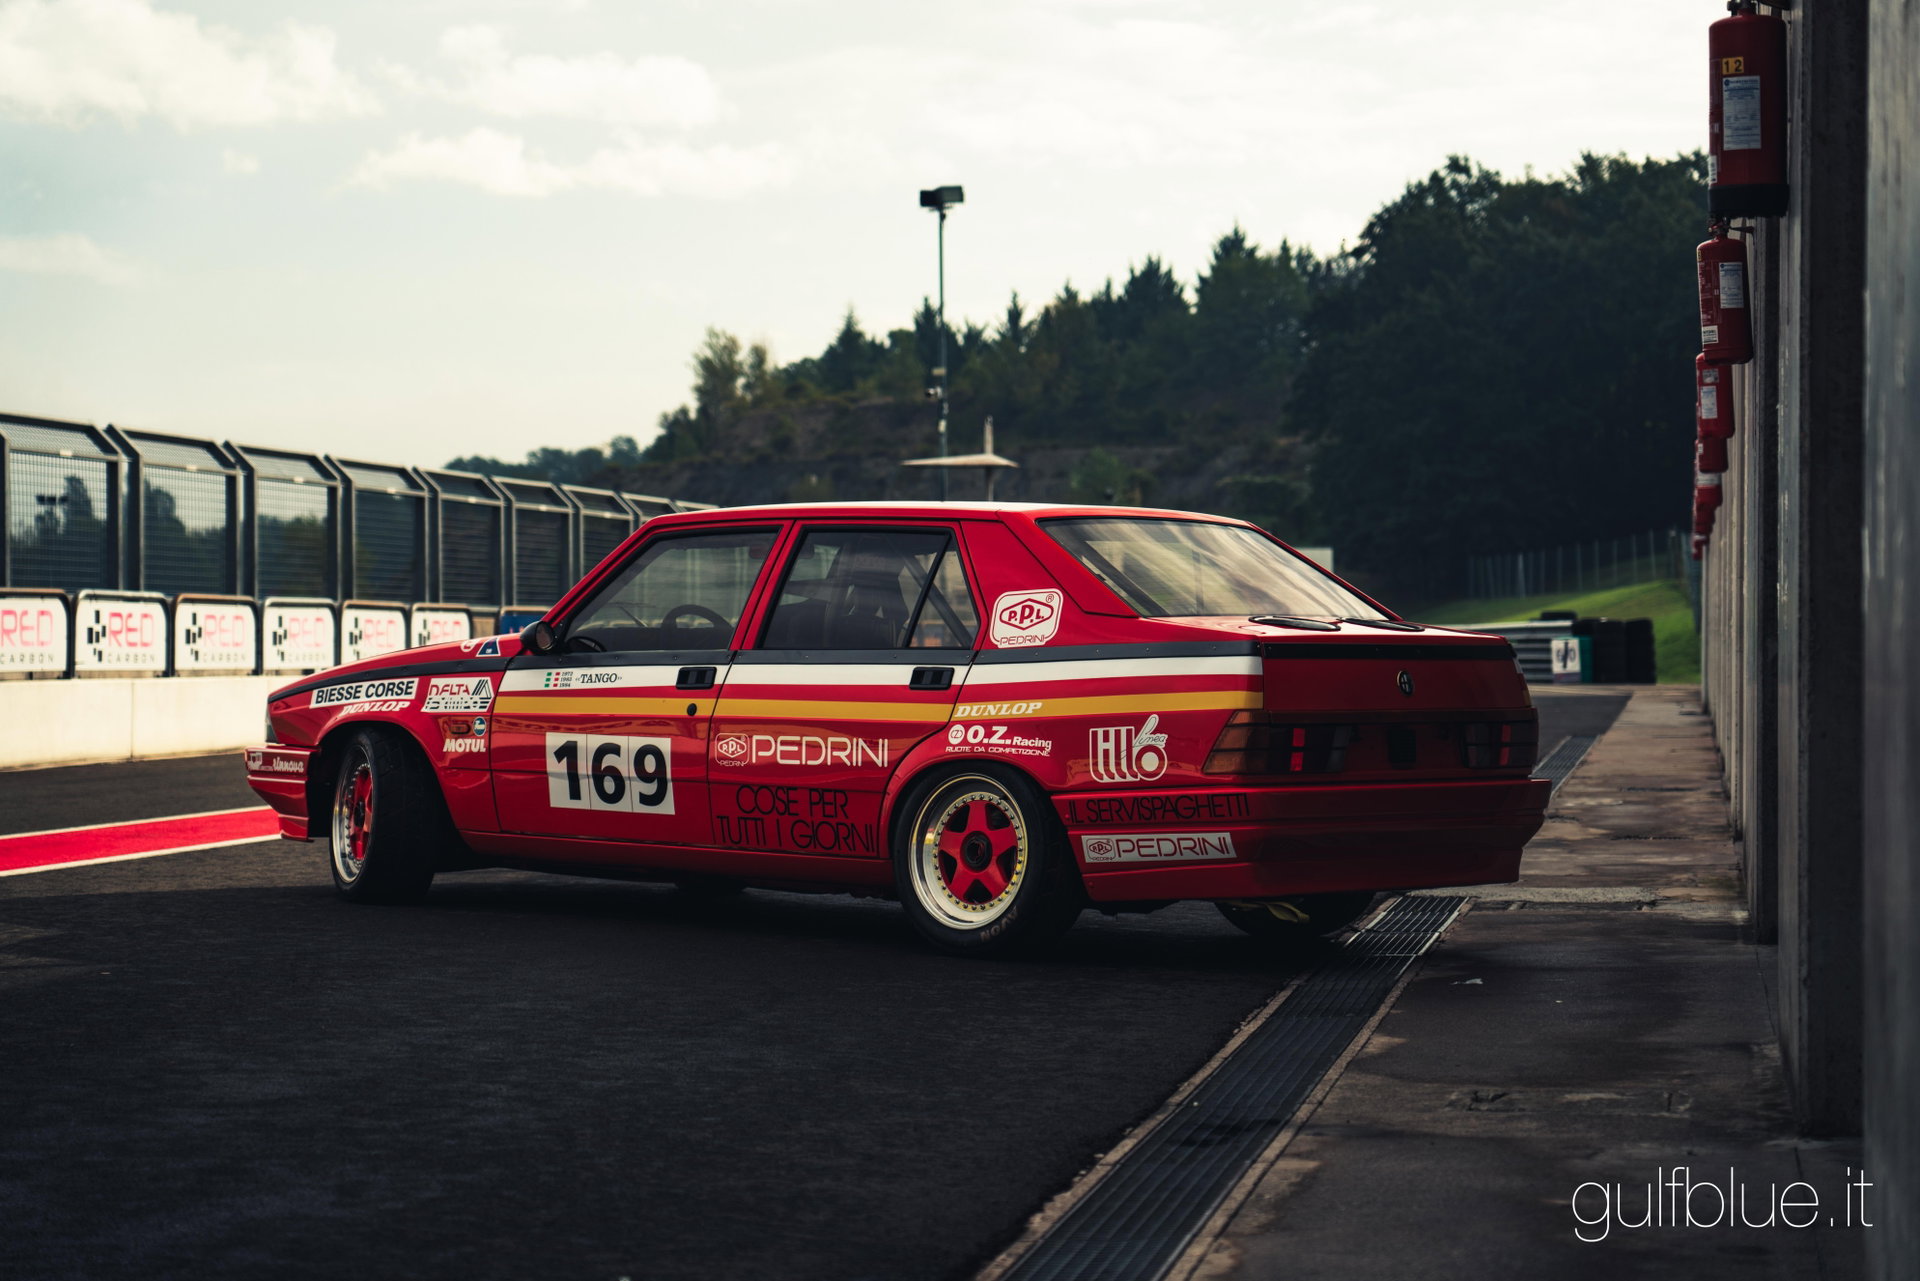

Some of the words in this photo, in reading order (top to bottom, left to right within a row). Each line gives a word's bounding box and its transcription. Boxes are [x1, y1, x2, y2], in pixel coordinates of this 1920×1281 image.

[1, 610, 54, 647] RED
[109, 612, 155, 647] RED
[203, 614, 245, 647] RED
[288, 617, 325, 647] RED
[364, 619, 396, 648] RED
[999, 635, 1045, 645] PEDRINI
[0, 653, 54, 664] CARBON
[107, 652, 156, 664] CARBON
[203, 652, 247, 663] CARBON
[315, 684, 363, 704] BIESSE
[365, 680, 415, 698] CORSE
[429, 684, 470, 696] DELTA
[339, 701, 411, 717] DUNLOP
[954, 702, 1042, 718] DUNLOP
[443, 739, 486, 753] MOTUL
[752, 735, 888, 768] PEDRINI
[988, 747, 1050, 756] COMPETIZIONE
[1013, 736, 1052, 750] Racing
[553, 740, 668, 807] 169
[736, 785, 799, 816] COSE
[810, 788, 848, 819] PER
[1069, 800, 1084, 823] IL
[1087, 793, 1249, 823] SERVISPAGHETTI
[716, 815, 769, 847] TUTTI
[791, 820, 876, 852] GIORNI
[1114, 836, 1230, 859] PEDRINI
